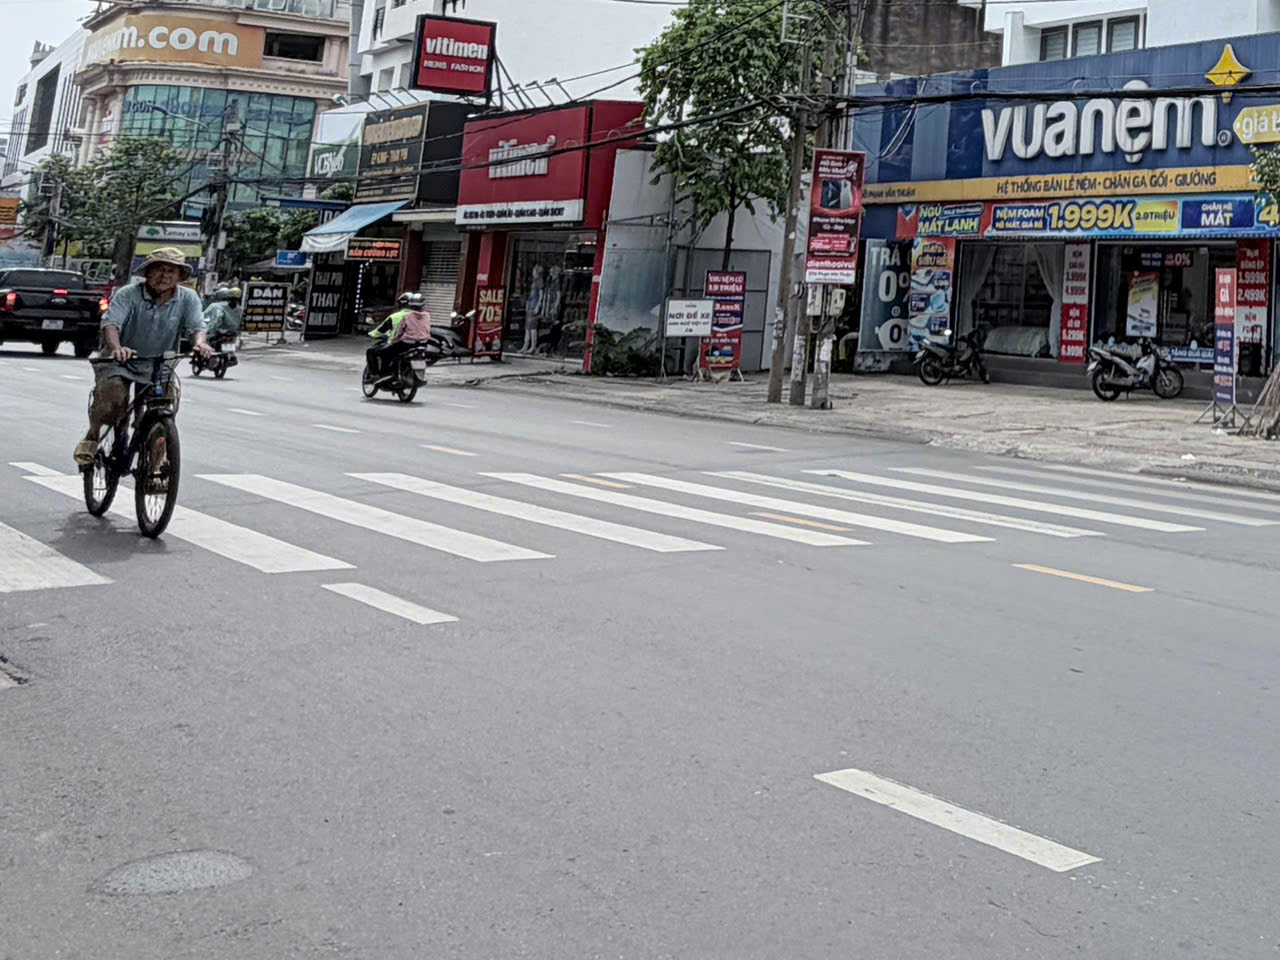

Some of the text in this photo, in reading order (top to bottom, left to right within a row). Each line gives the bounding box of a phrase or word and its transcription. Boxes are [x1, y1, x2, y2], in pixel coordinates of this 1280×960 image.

[425, 36, 489, 60] vitimen
[450, 63, 484, 73] FASHION
[996, 170, 1217, 194] HỆ THỐNG BÁN LẺ NỆM CHĂN GA GỐI GIƯỜNG
[996, 207, 1044, 220] NỆM FOAM
[1048, 202, 1134, 230] 1.999K
[1201, 210, 1233, 226] MÁT
[918, 218, 944, 233] MÁT
[1175, 252, 1190, 266] 0%
[312, 293, 340, 307] THAY
[480, 289, 504, 303] SALE
[479, 304, 502, 322] 70%
[686, 310, 698, 319] ĐỂ
